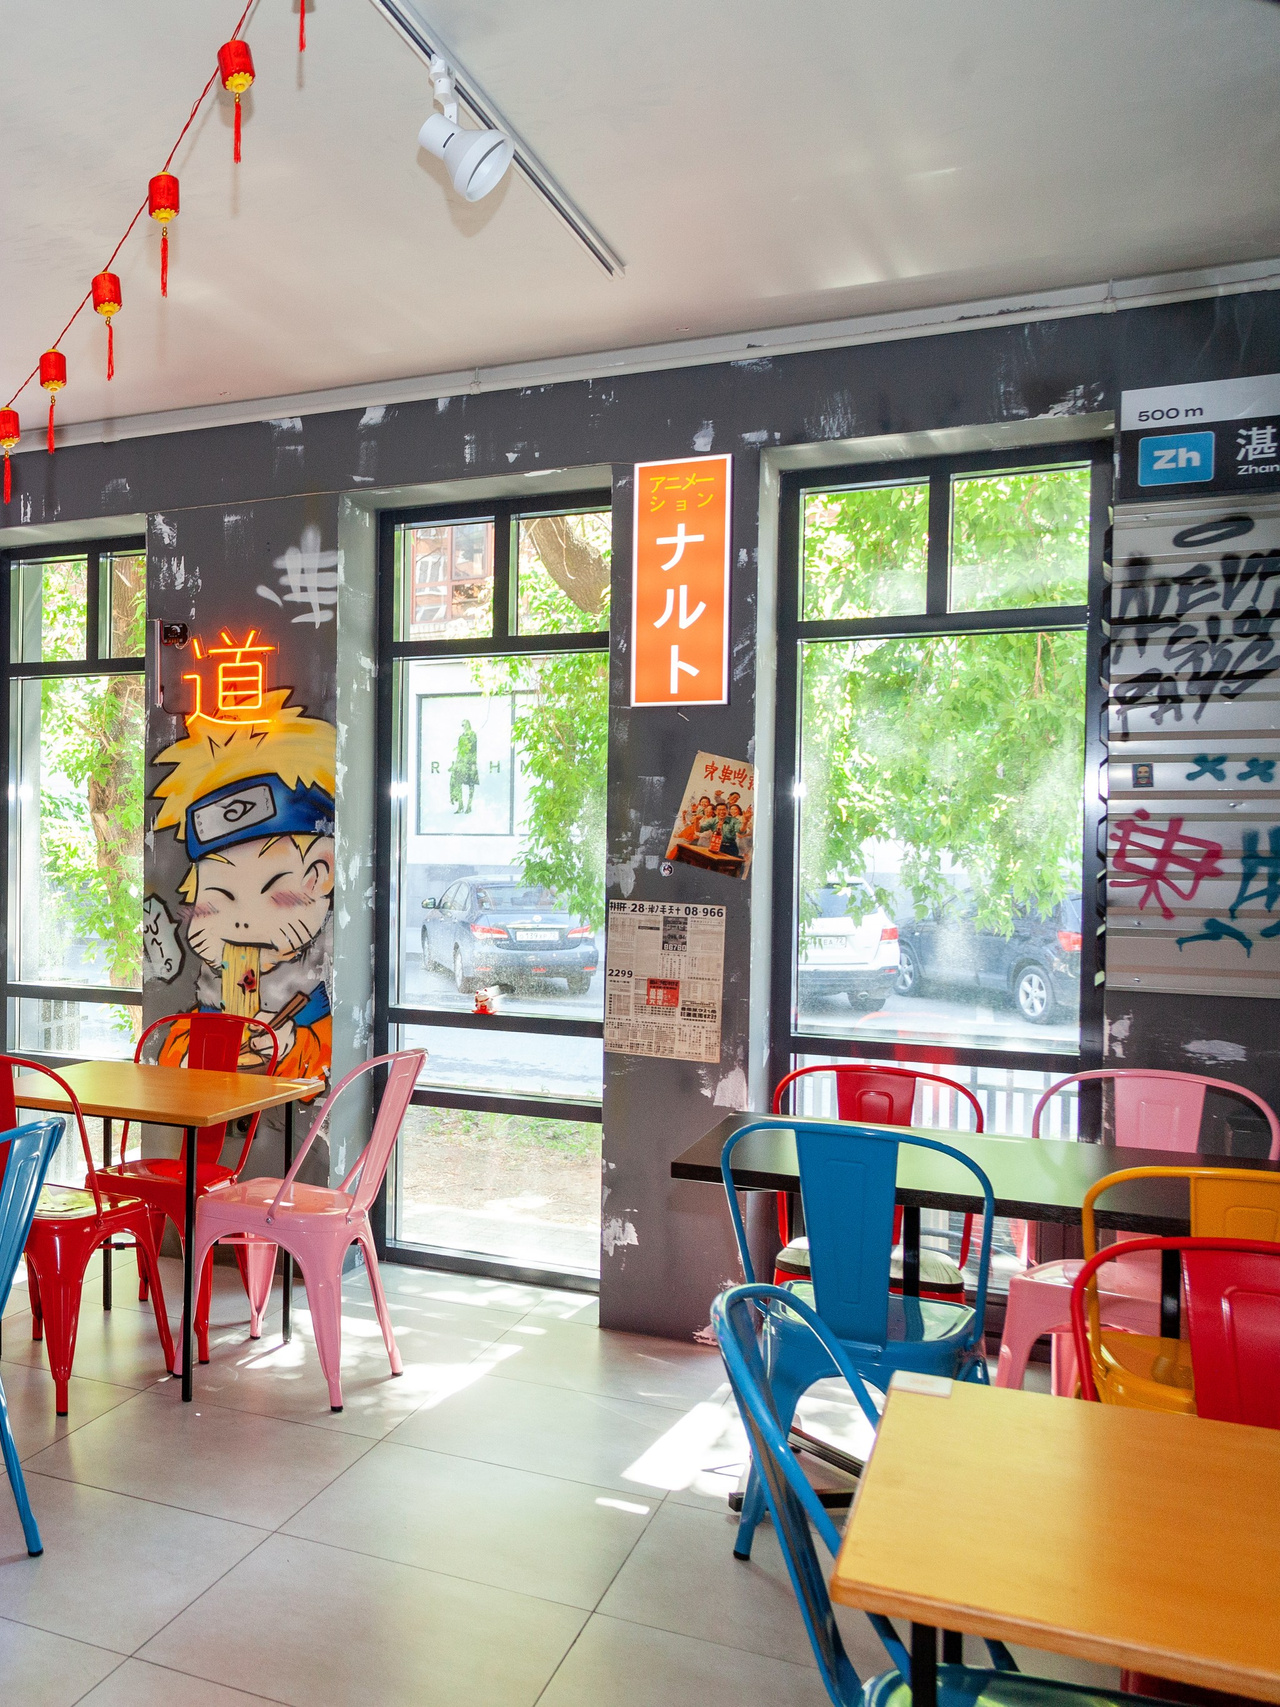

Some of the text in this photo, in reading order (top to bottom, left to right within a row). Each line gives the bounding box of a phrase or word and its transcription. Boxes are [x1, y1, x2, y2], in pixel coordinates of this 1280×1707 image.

[1138, 407, 1203, 422] 500 m
[1236, 425, 1277, 461] 湛
[1153, 447, 1201, 470] Zh
[650, 473, 714, 493] アニメー
[653, 523, 706, 694] ナルト
[183, 629, 276, 726] 道
[608, 969, 633, 978] 2299
